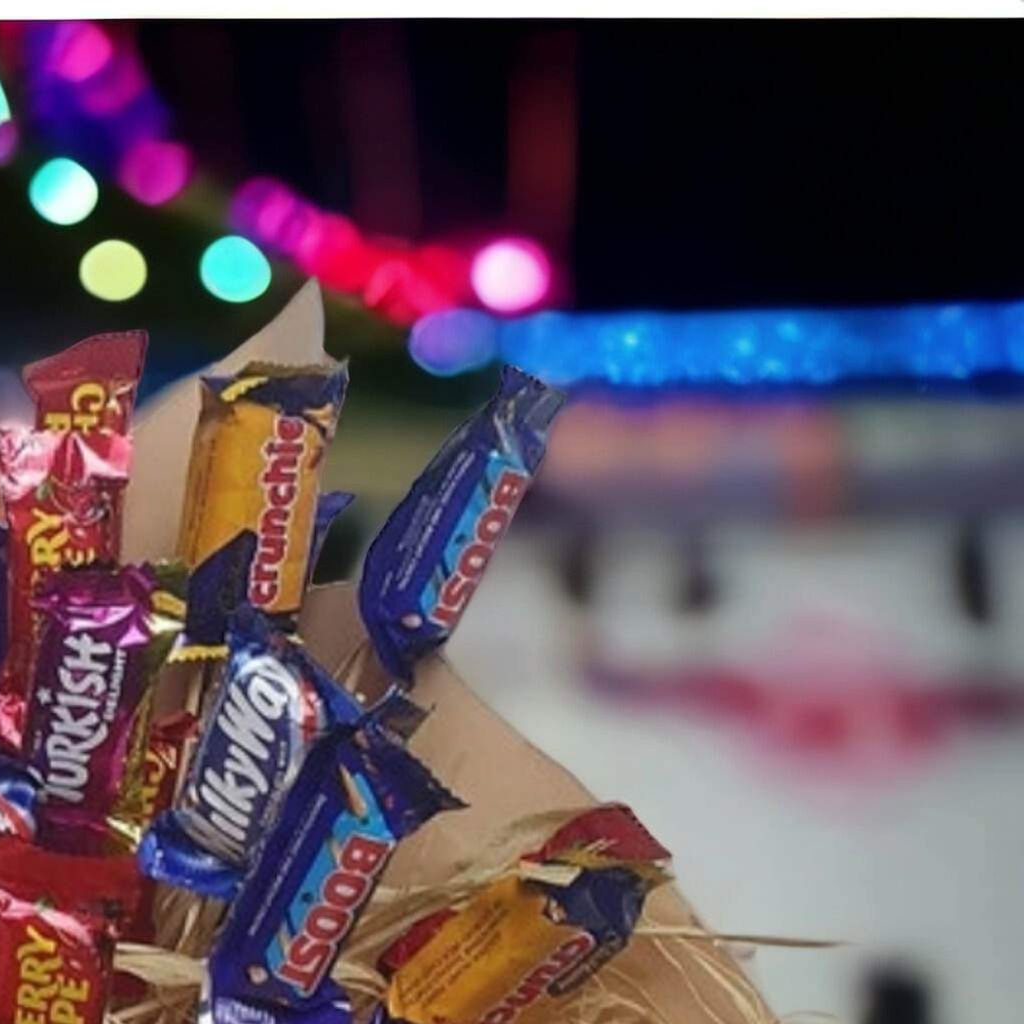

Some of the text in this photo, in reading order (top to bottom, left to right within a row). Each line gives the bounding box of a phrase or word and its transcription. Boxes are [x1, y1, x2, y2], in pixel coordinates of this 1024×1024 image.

[247, 415, 309, 609] crunchie
[428, 468, 529, 629] BOOST
[27, 632, 112, 803] TURKISH
[276, 833, 396, 997] BOOST
